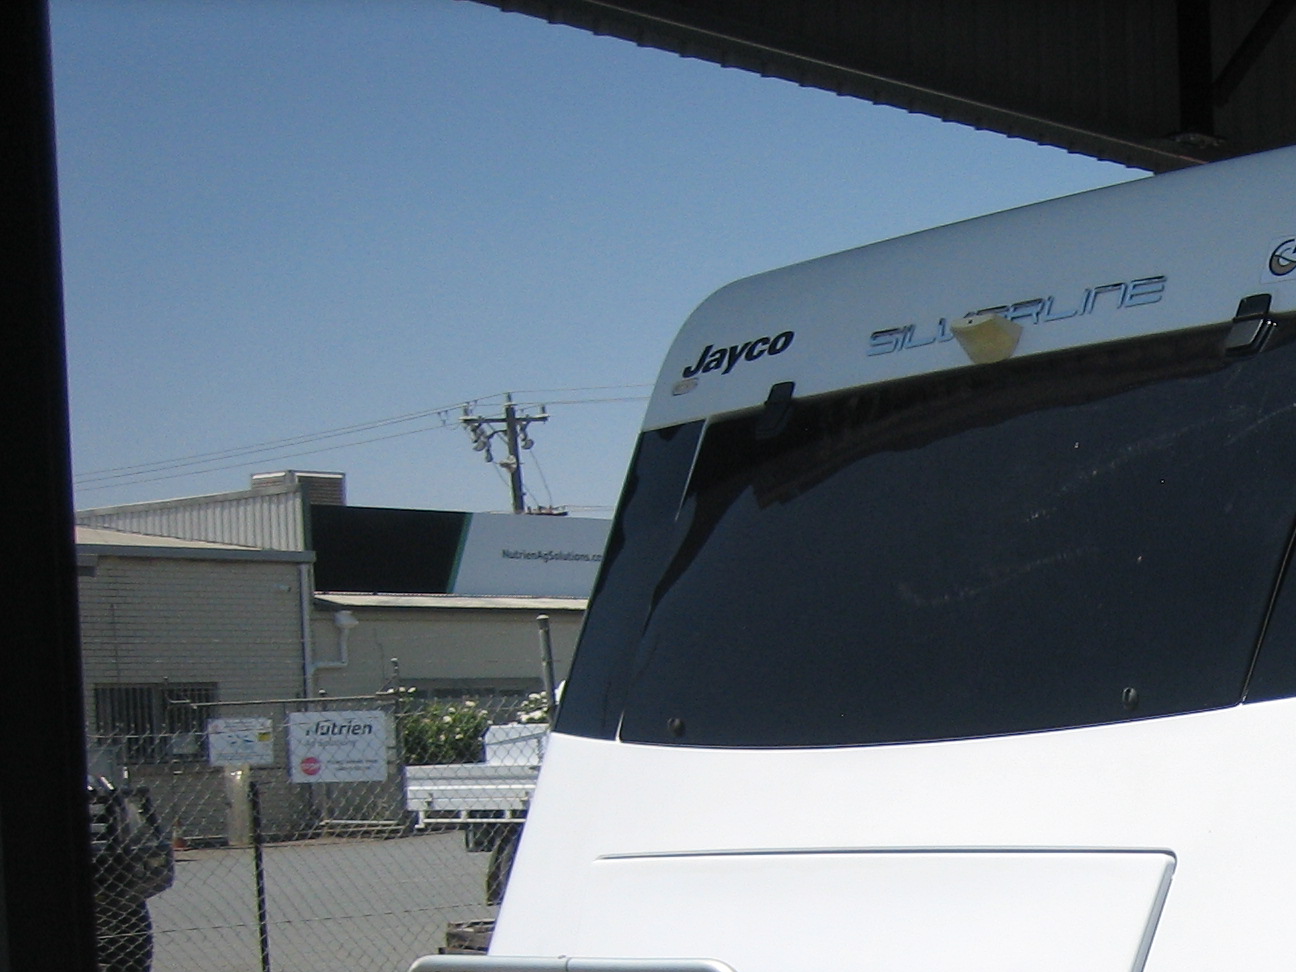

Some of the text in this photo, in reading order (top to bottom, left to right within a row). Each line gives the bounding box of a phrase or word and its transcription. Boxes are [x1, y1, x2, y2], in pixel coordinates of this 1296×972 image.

[867, 274, 1168, 357] SILVRLINE
[682, 331, 795, 378] Jayco
[502, 549, 604, 563] NutrienAgSolutions.co
